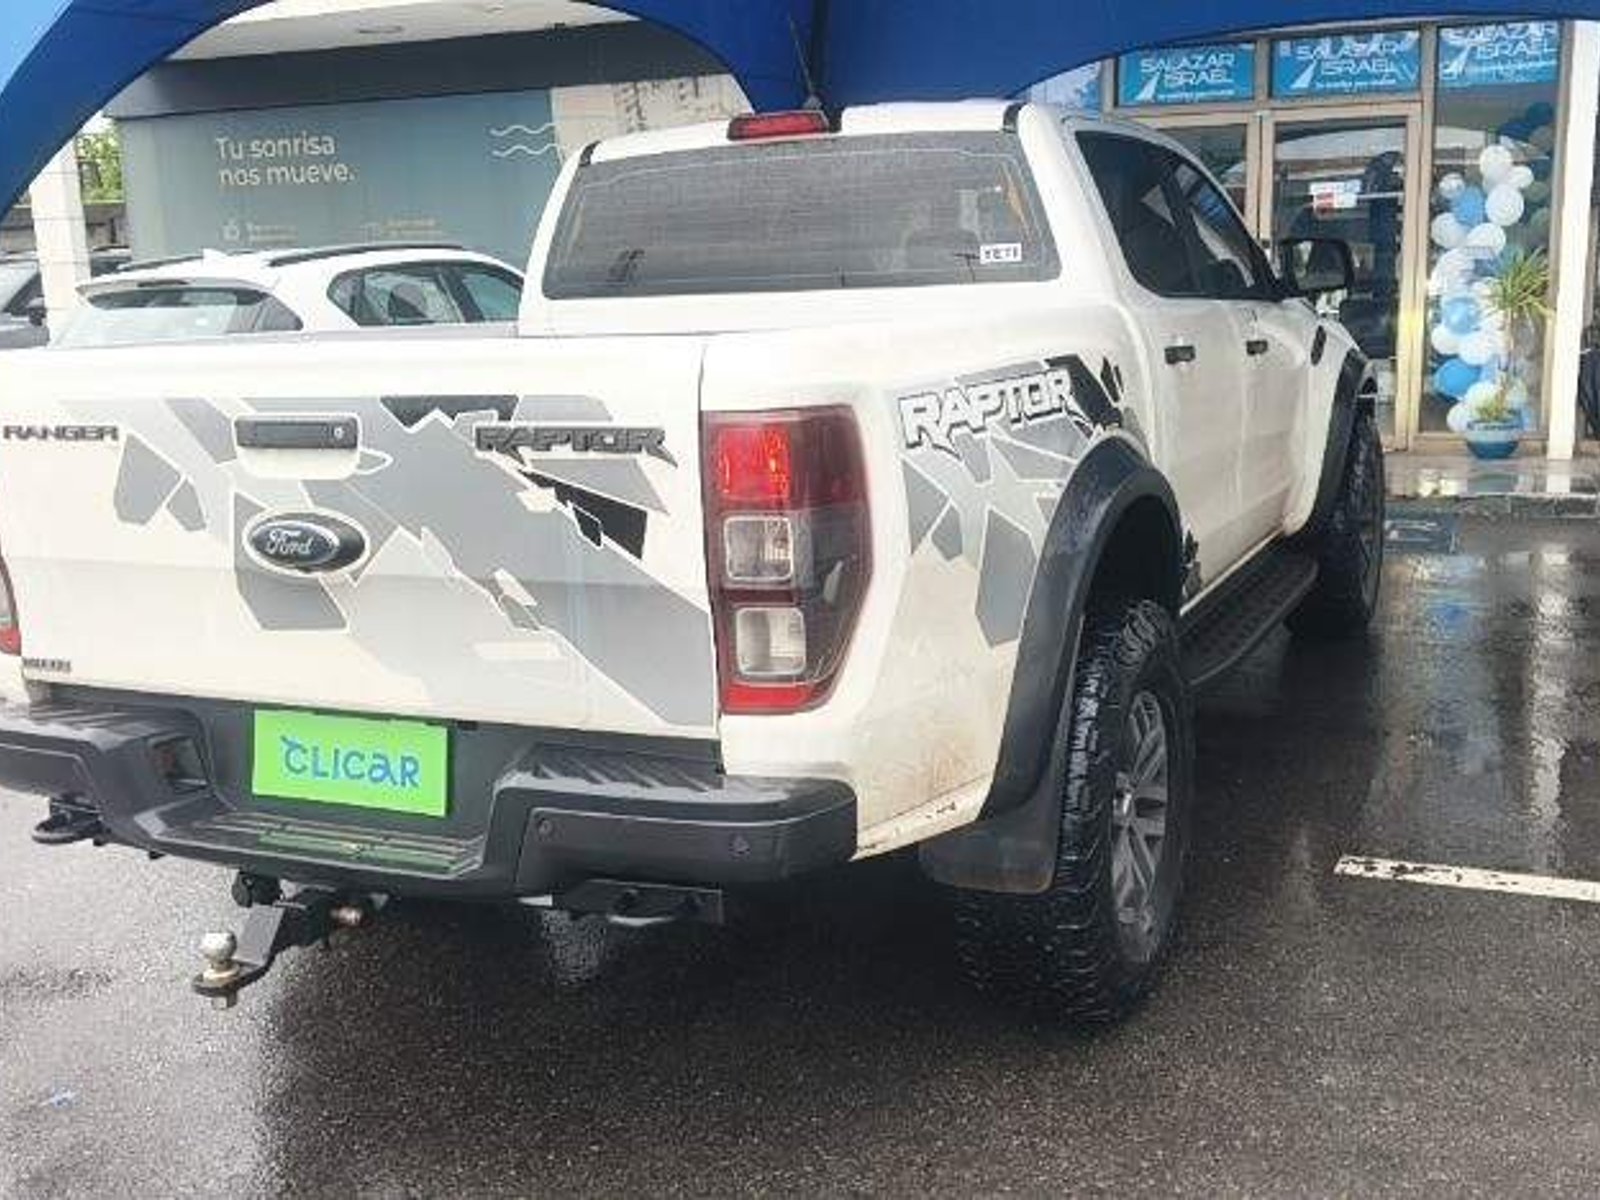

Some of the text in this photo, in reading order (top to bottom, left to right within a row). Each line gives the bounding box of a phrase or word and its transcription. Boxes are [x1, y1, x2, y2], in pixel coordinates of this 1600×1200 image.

[1296, 40, 1396, 60] SALAZAR
[1475, 38, 1558, 59] ISRAEL
[1140, 53, 1235, 73] SALAZAR
[1320, 58, 1396, 75] ISRAEL
[1164, 68, 1233, 88] ISRAEL
[215, 131, 336, 160] Tu sonrisa
[220, 163, 356, 186] nos mueve.
[899, 368, 1080, 457] RAPTOR
[3, 424, 119, 441] RANGER
[475, 426, 678, 468] RAPTOR
[264, 528, 315, 556] Ford
